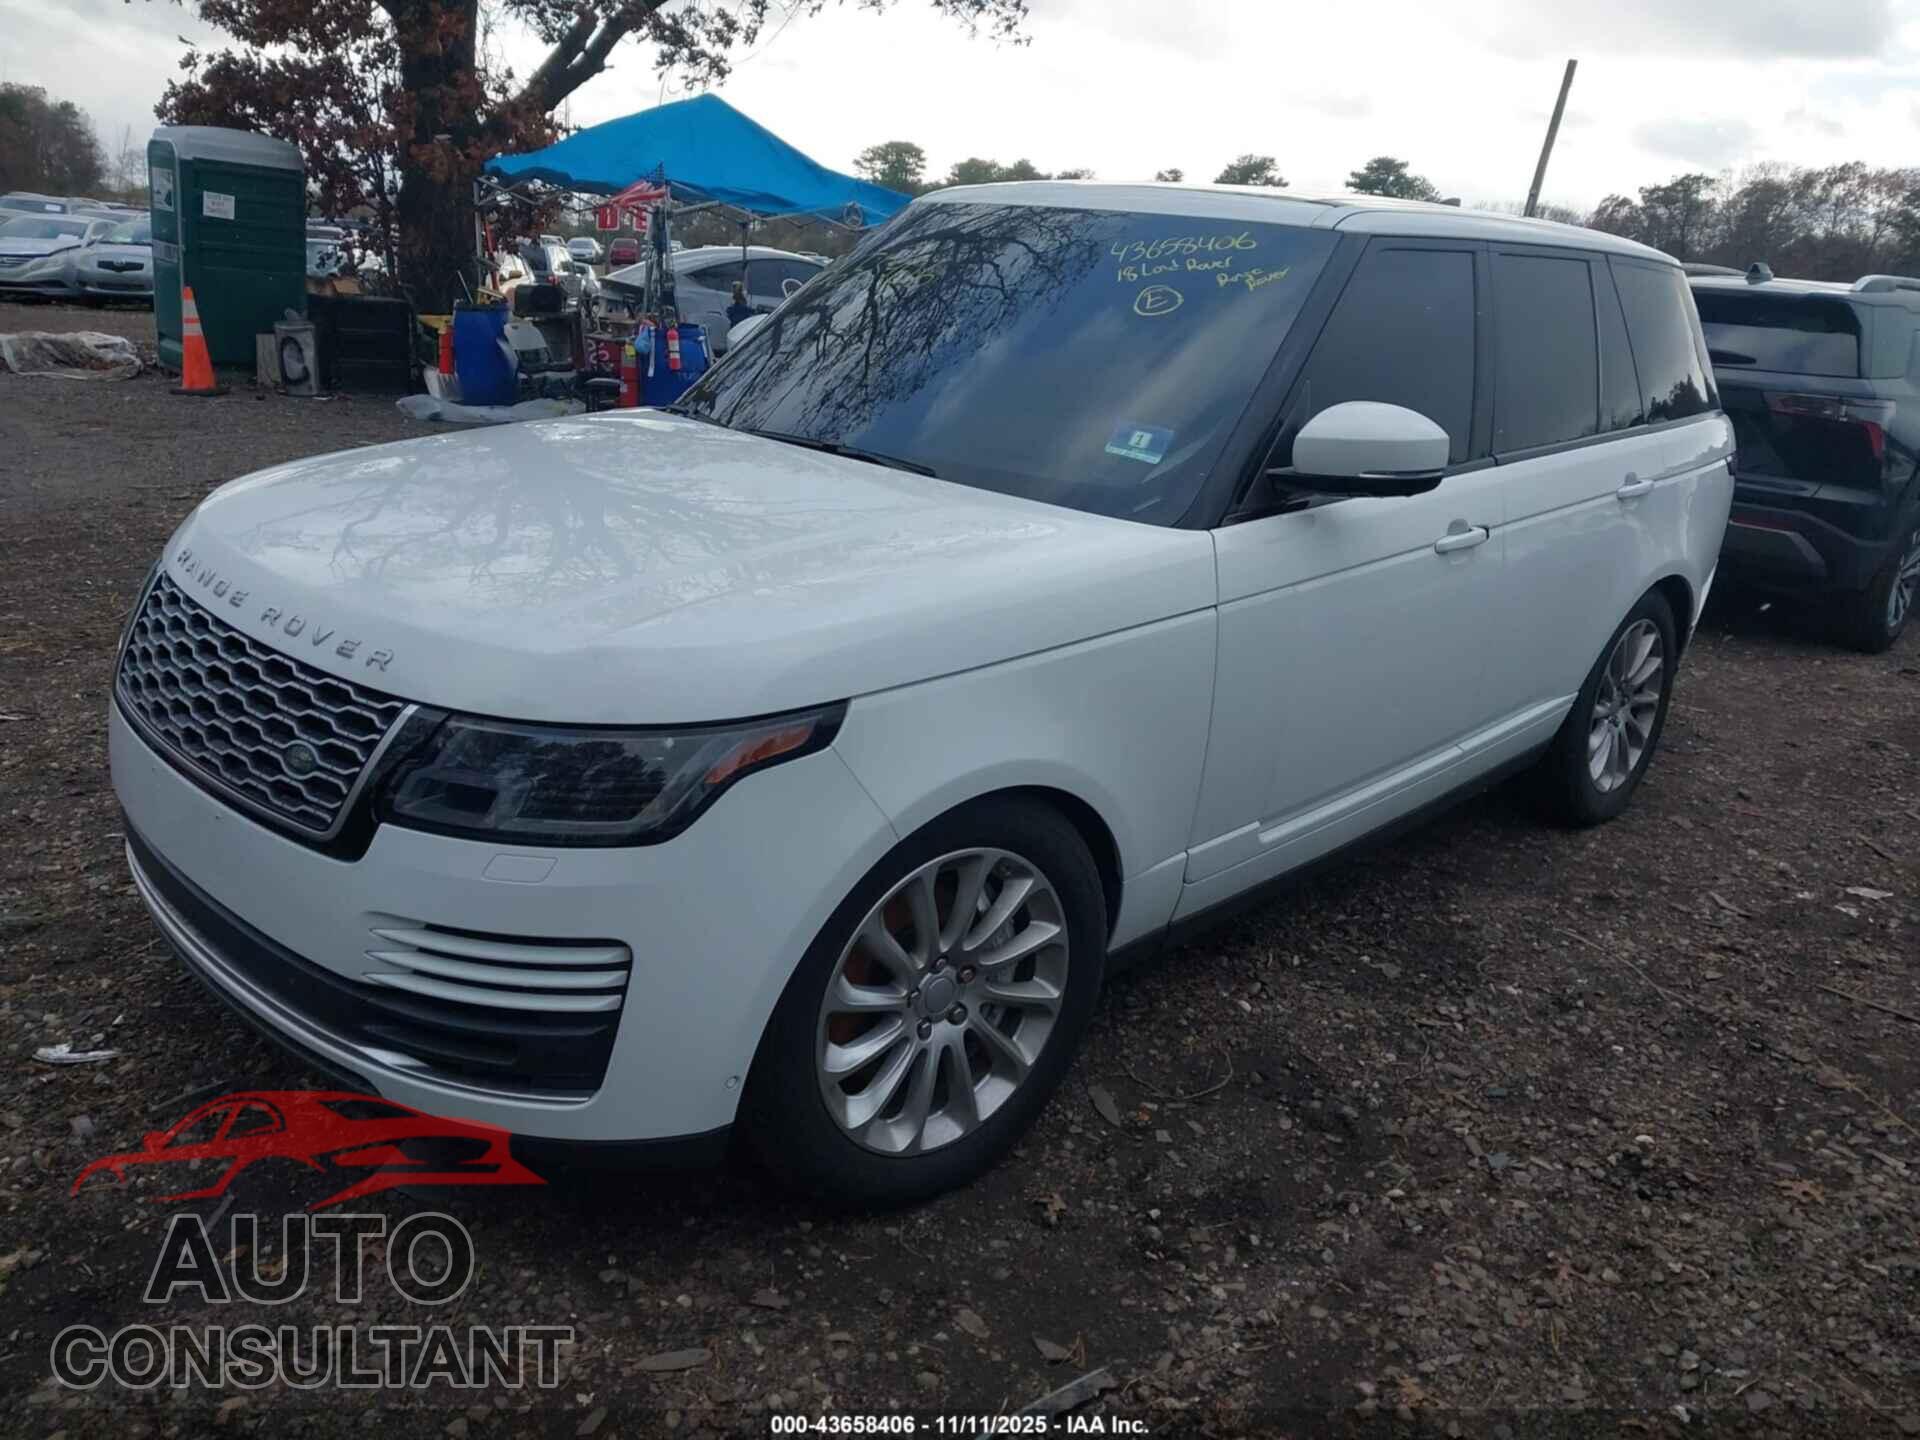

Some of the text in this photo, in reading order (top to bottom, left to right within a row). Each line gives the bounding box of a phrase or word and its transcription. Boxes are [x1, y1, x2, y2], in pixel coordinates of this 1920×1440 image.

[1111, 232, 1257, 262] 43658406
[1186, 256, 1233, 272] Rover
[177, 547, 394, 672] RANGE ROVER
